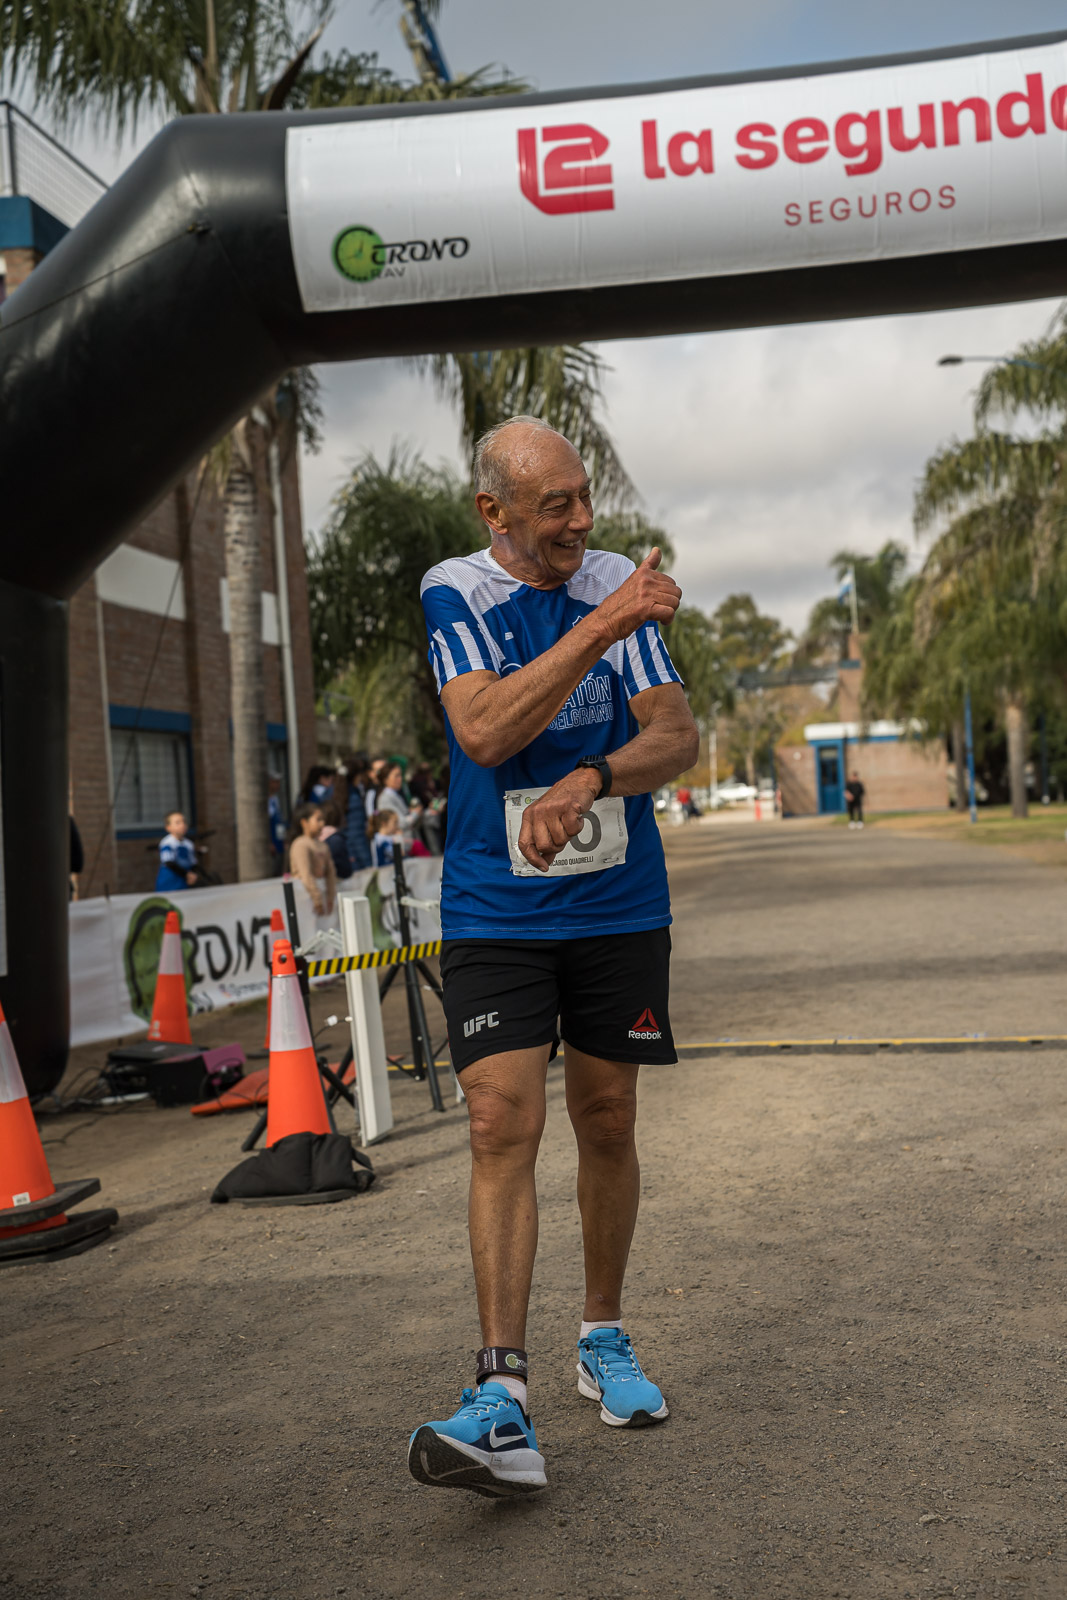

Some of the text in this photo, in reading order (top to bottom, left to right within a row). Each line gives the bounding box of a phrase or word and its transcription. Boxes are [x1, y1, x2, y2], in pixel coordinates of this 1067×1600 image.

[641, 119, 715, 180] la
[784, 185, 957, 227] SEGUROS
[463, 1011, 500, 1038] UFC
[628, 1030, 662, 1040] Reebok
